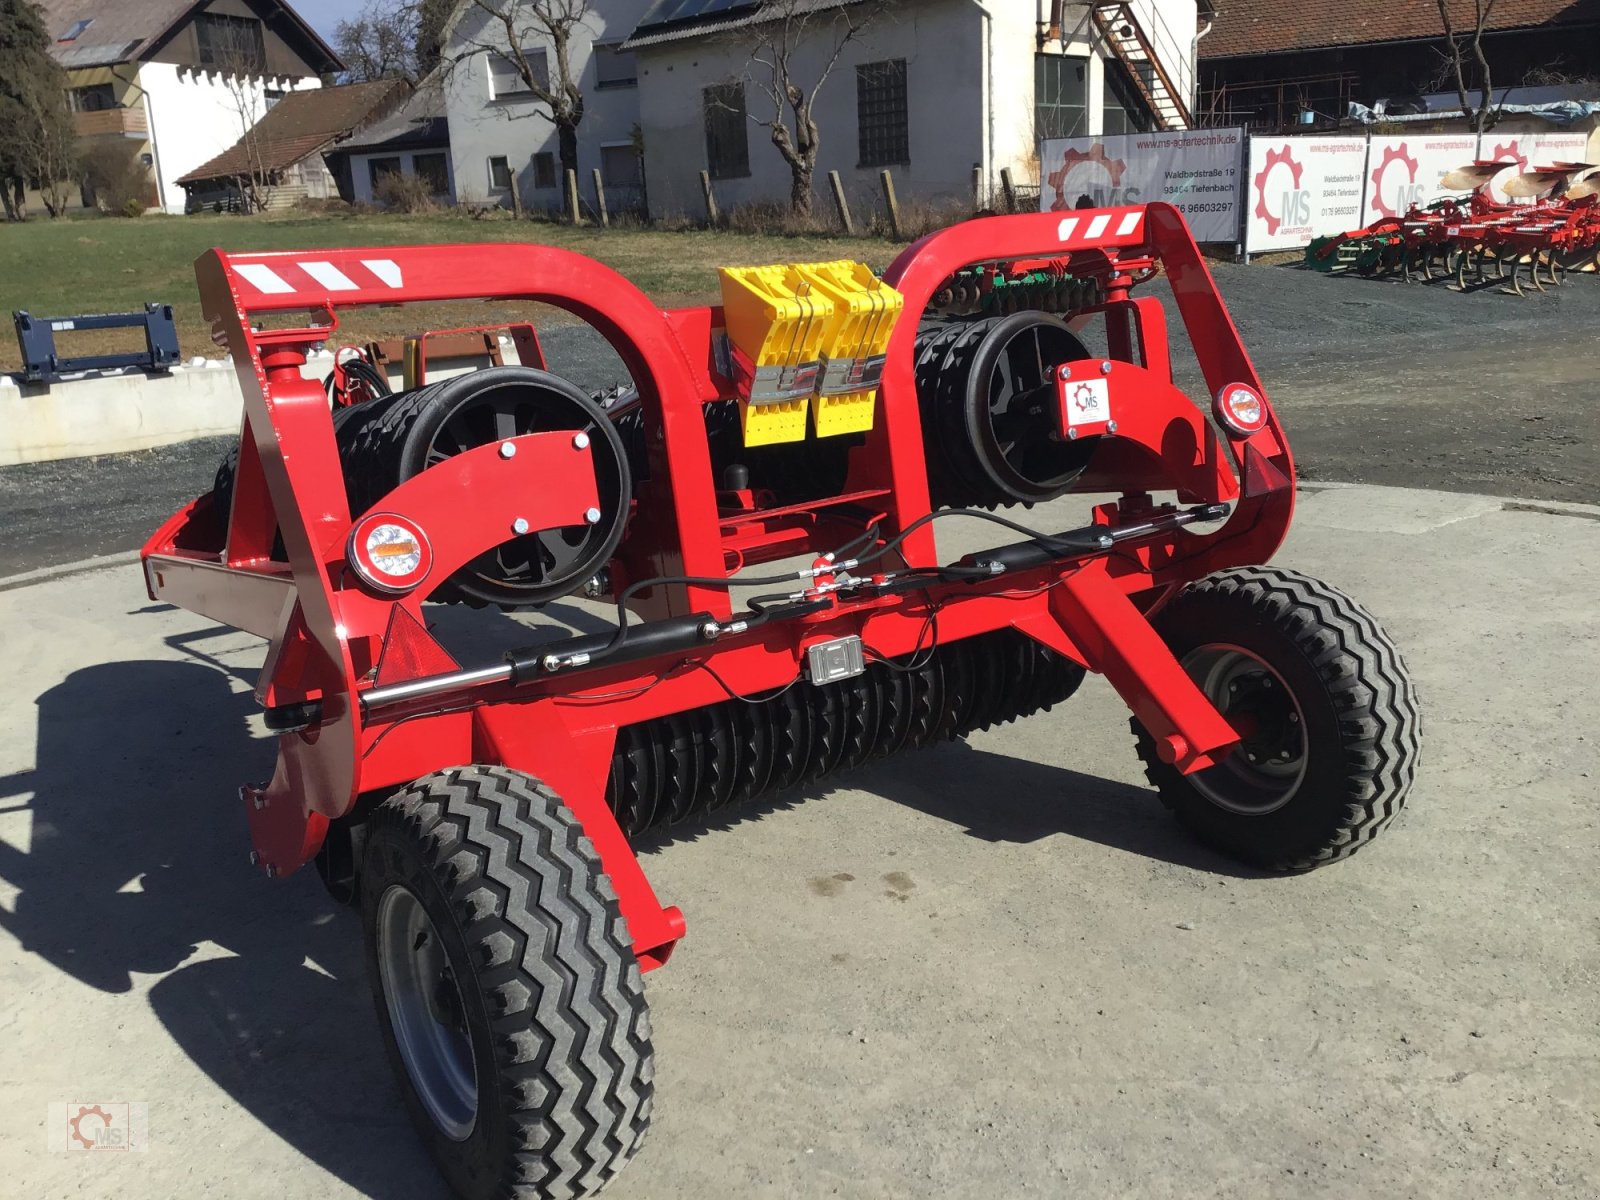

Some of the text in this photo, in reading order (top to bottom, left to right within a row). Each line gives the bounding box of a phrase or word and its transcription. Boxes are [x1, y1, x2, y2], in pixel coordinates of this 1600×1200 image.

[1137, 134, 1237, 150] www.ms-agrartechnik.de
[1164, 168, 1235, 179] Waldbadstraße 19
[1191, 184, 1234, 193] Tiefenbach
[1187, 202, 1233, 213] 96603297
[1281, 190, 1311, 227] MS
[1084, 396, 1098, 409] MS
